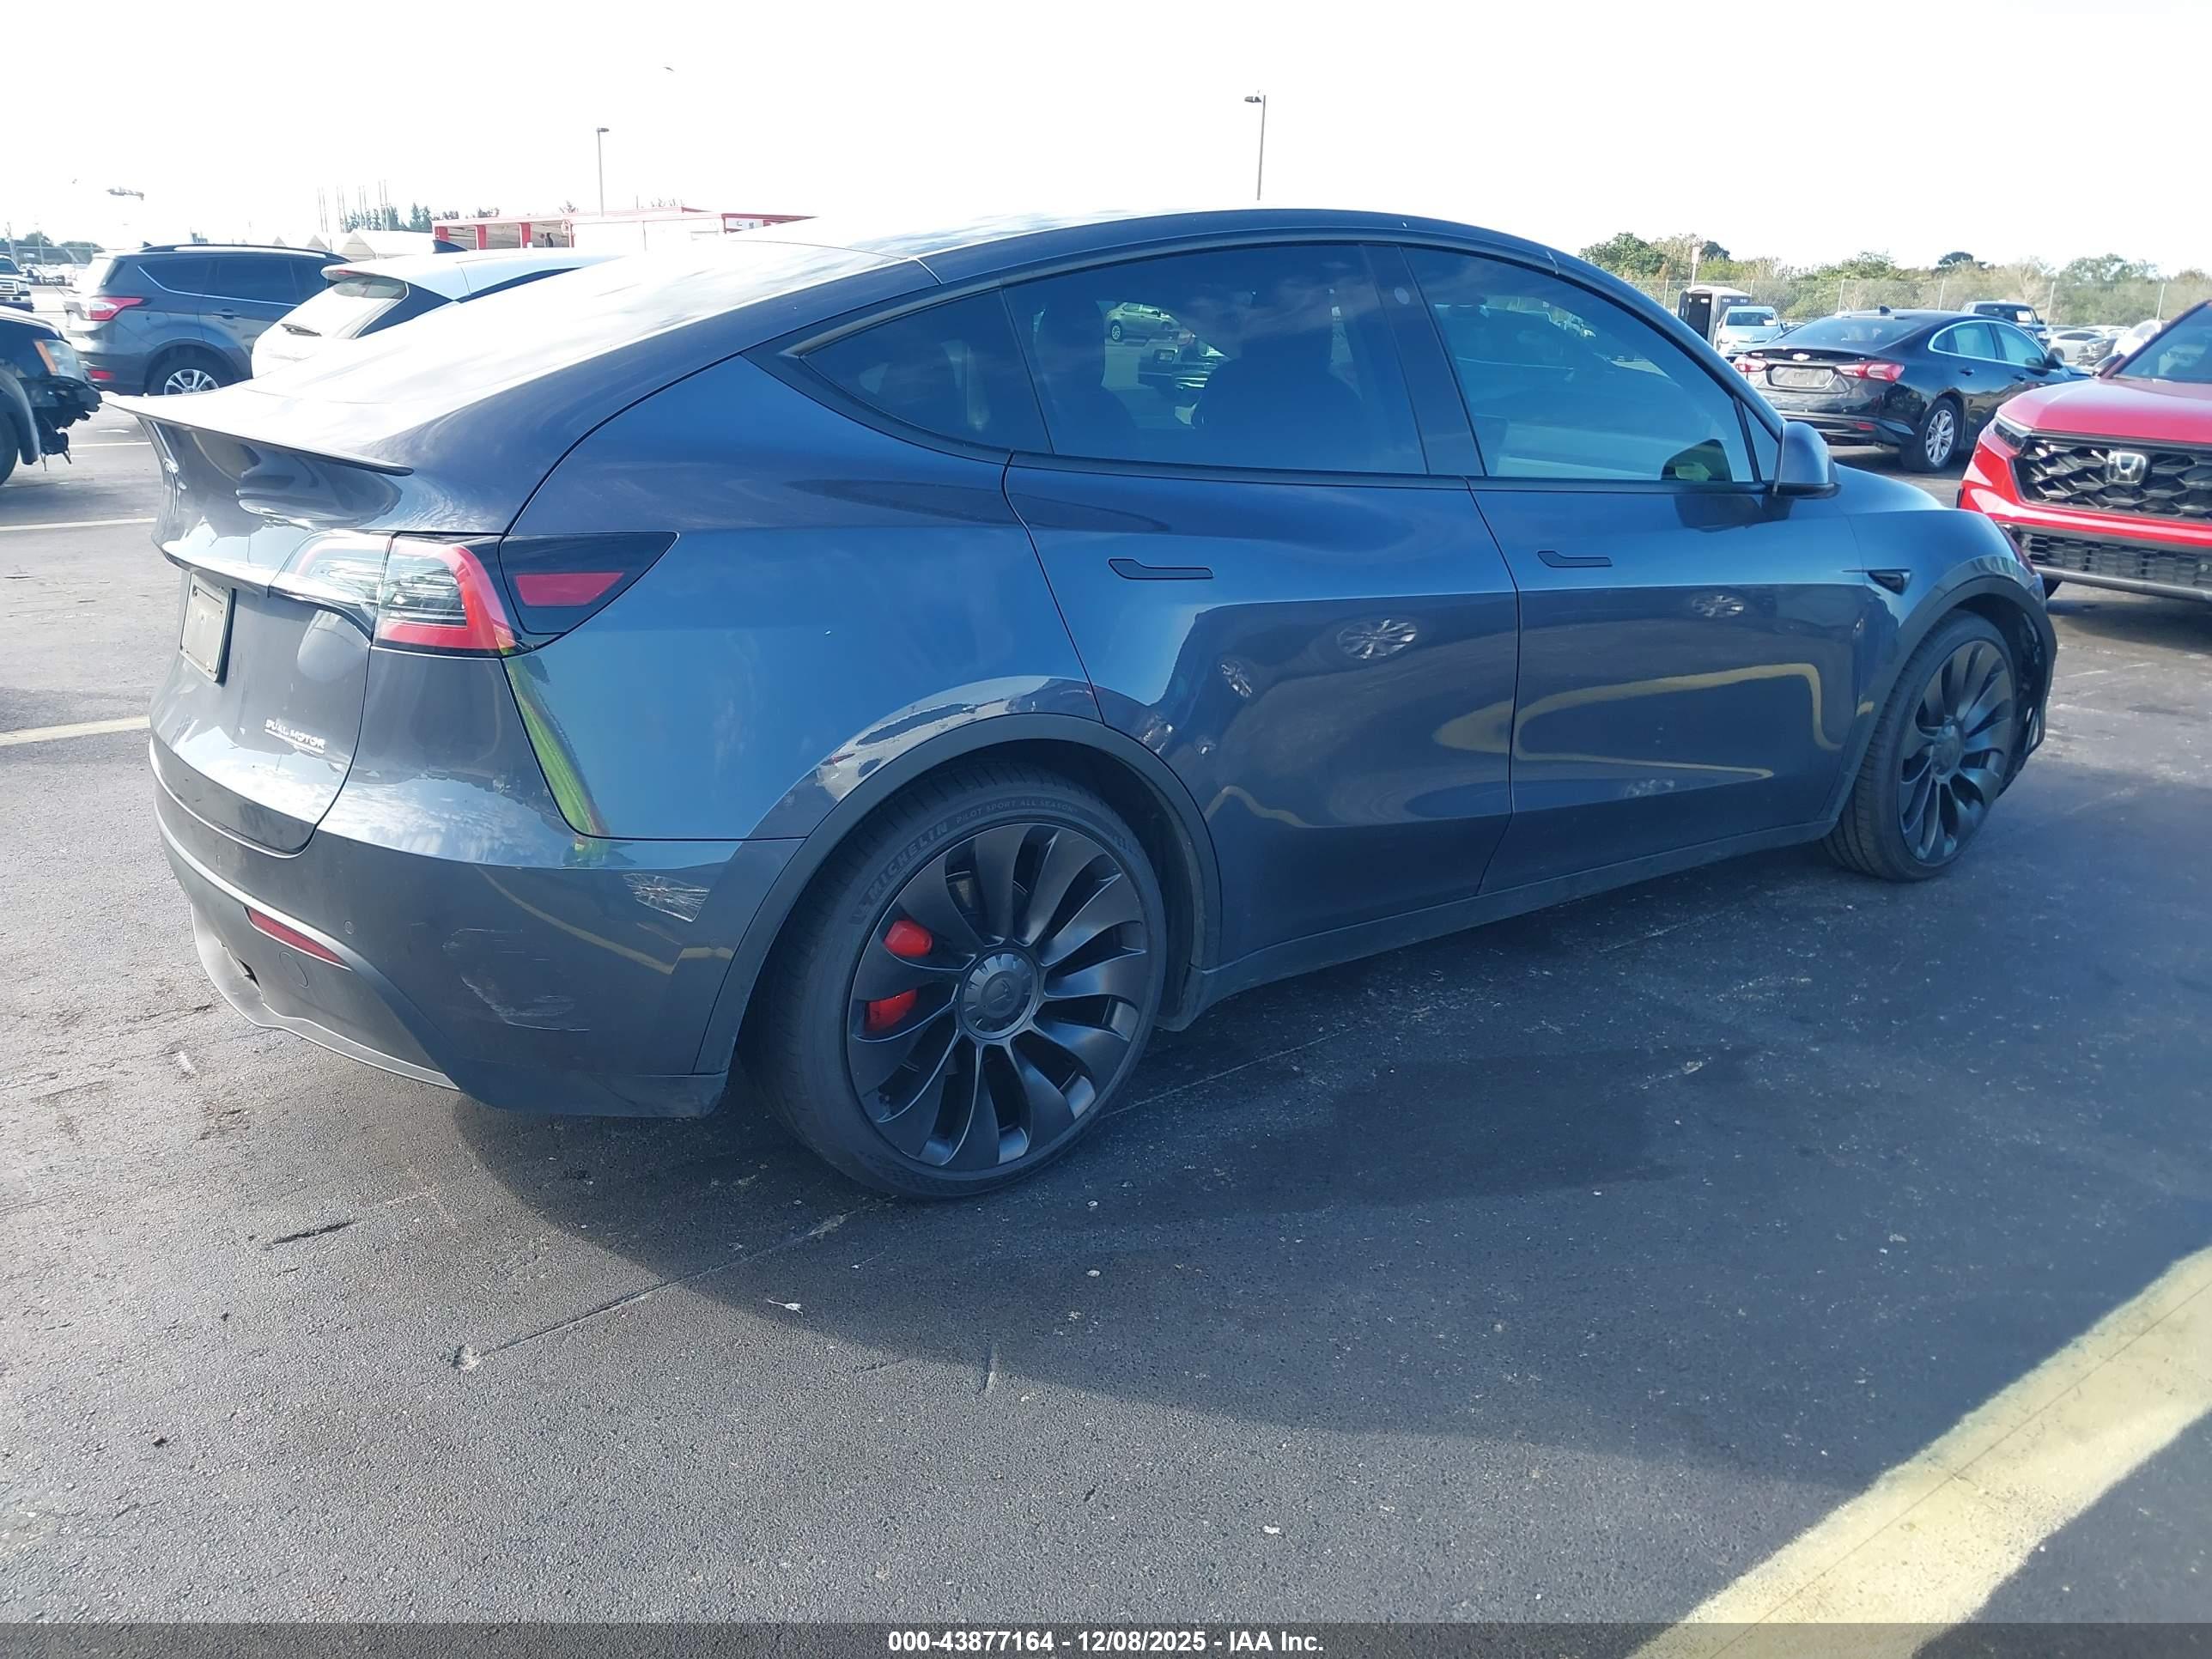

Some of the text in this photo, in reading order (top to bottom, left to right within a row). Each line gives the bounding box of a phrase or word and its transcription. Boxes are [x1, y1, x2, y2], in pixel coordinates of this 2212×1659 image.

[264, 718, 325, 750] DUAL MOTOR
[867, 821, 948, 901] MICHELIN
[956, 807, 982, 824] PILOT
[987, 799, 1016, 812] SPORT
